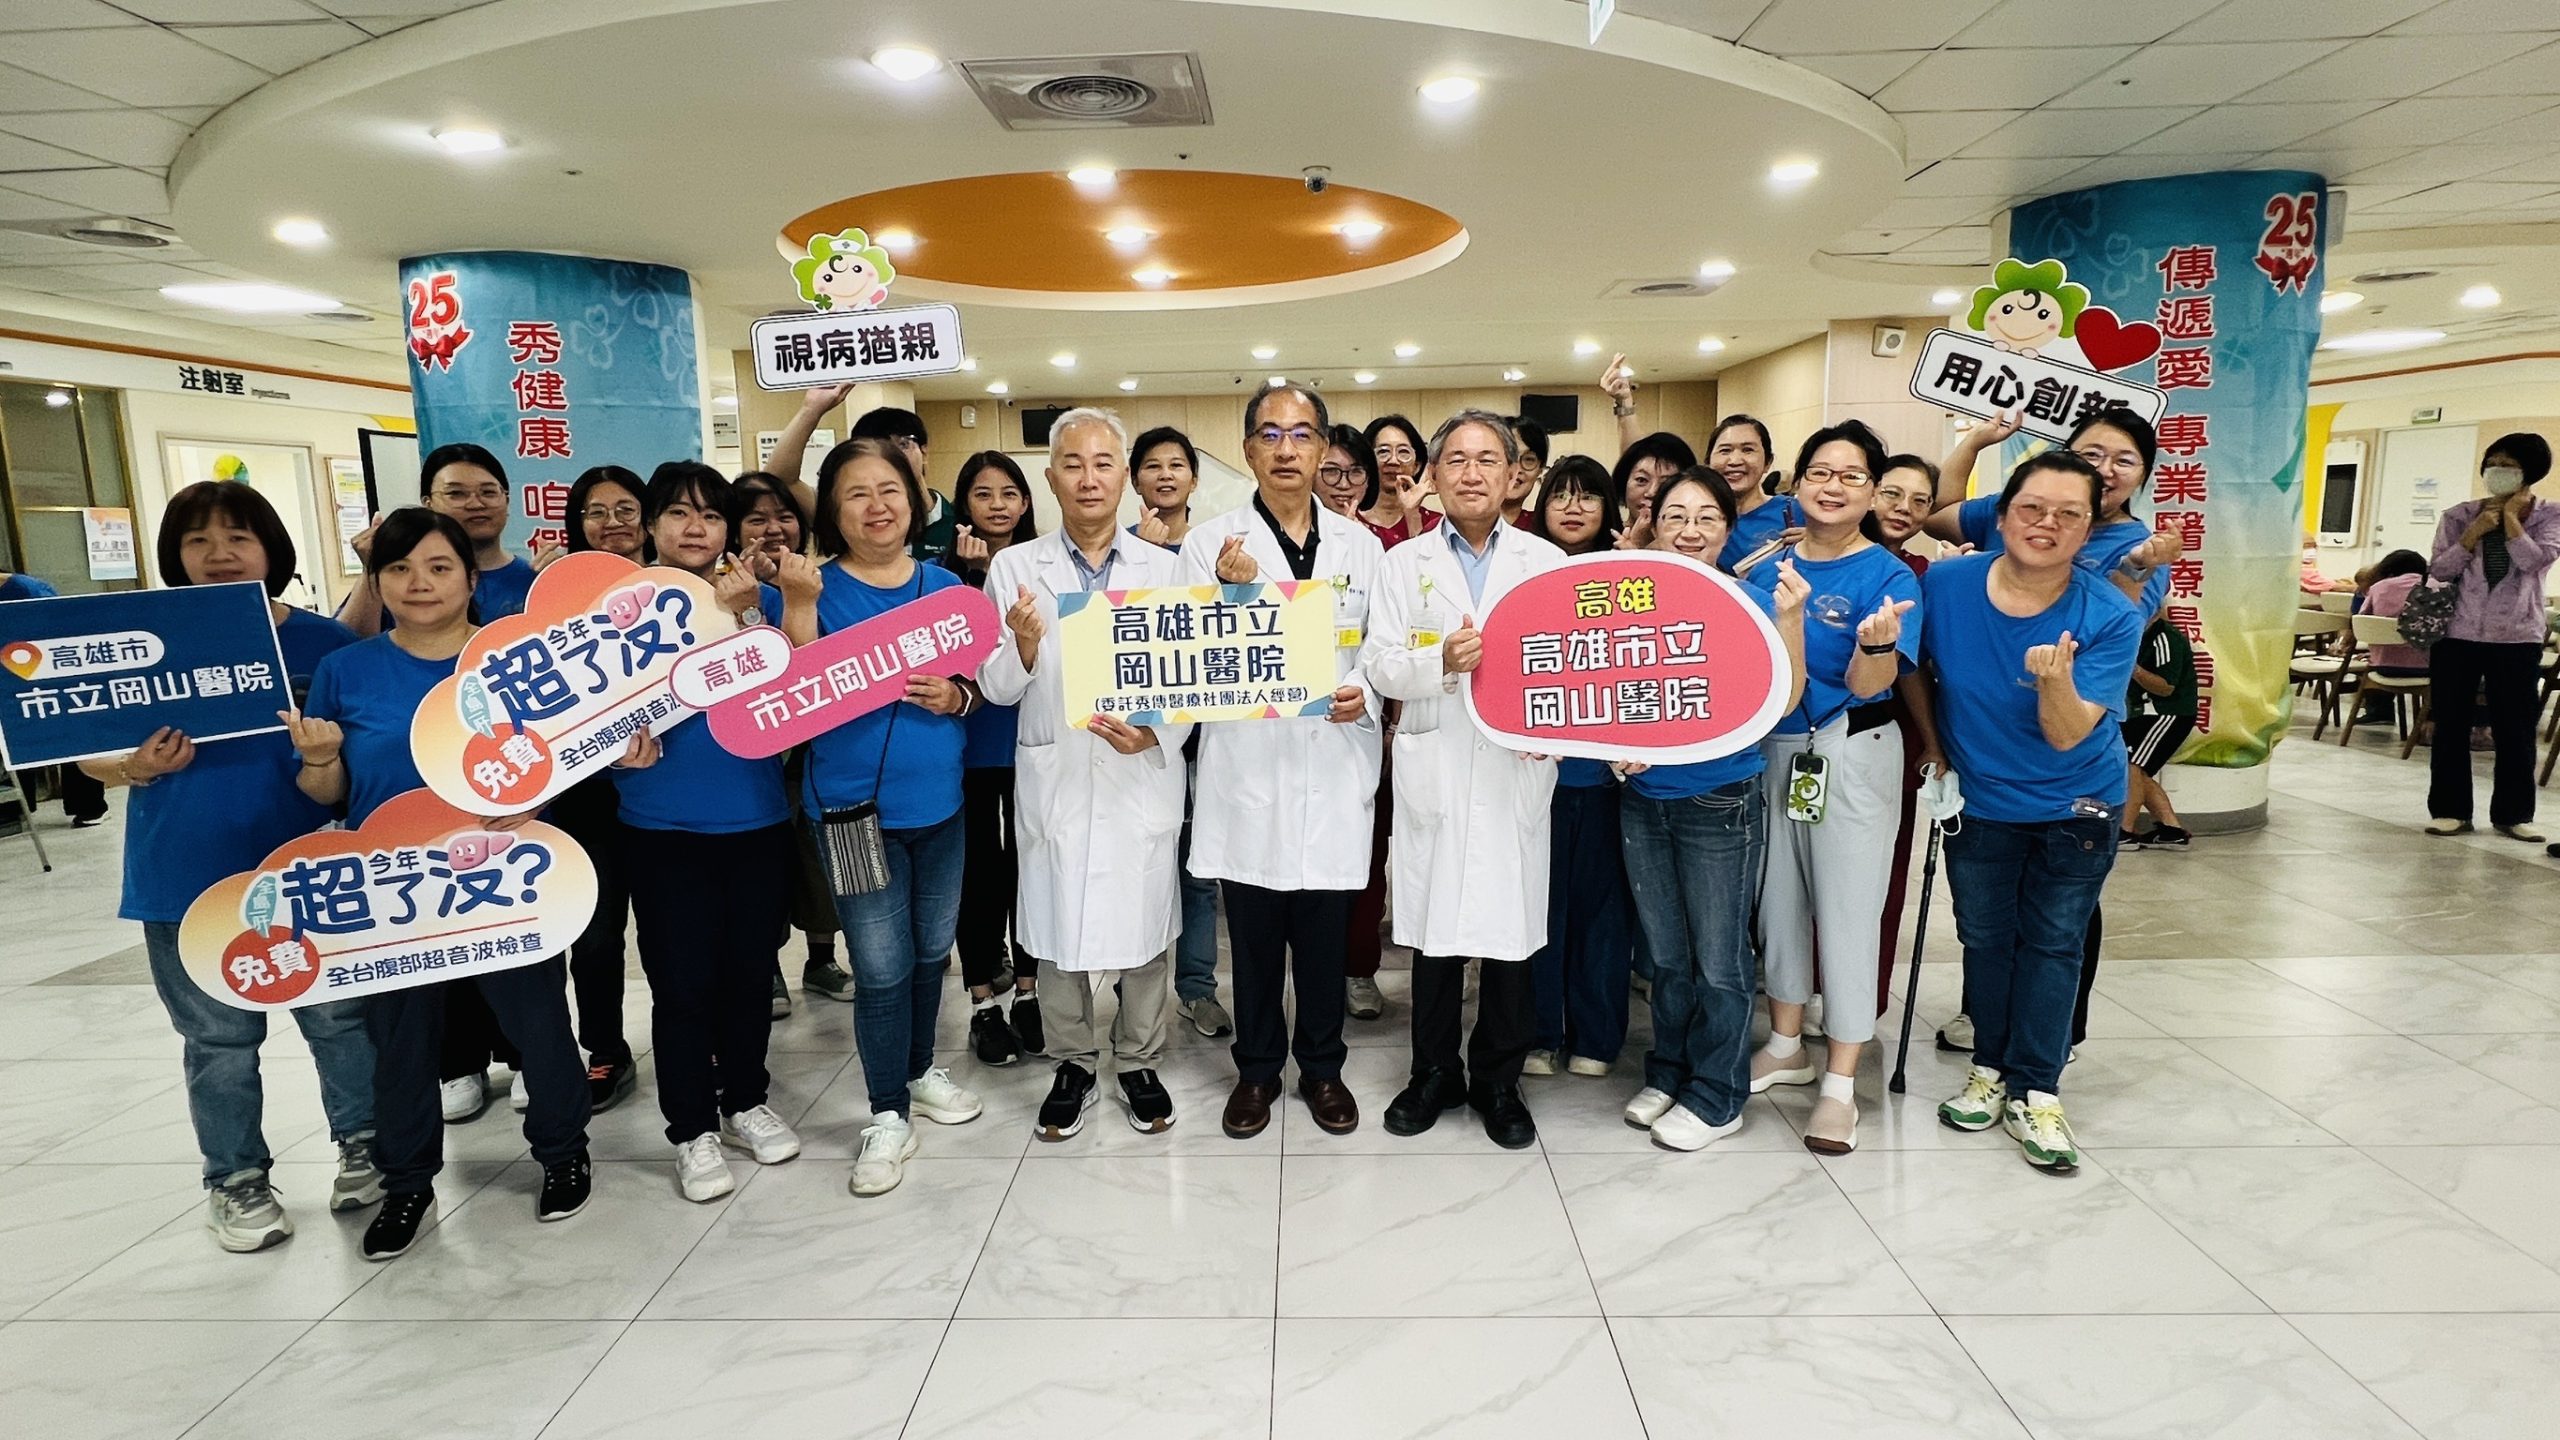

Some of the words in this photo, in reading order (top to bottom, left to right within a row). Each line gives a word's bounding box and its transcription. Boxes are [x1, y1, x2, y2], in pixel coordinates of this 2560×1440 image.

[2264, 195, 2316, 247] 25
[409, 273, 460, 328] 25
[2157, 246, 2216, 389] 傳遞愛
[774, 322, 939, 373] 視病猶親
[178, 365, 245, 395] 注射室
[508, 322, 571, 458] 秀健康
[1110, 599, 1284, 644] 高雄市立
[1574, 576, 1656, 619] 高雄
[48, 638, 149, 669] 高雄市
[547, 618, 590, 650] 今年
[1520, 621, 1707, 676] 高雄市立
[15, 661, 273, 719] 市立岡山醫院
[697, 644, 768, 692] 高雄
[746, 612, 974, 731] 市立岡山醫院
[1115, 644, 1286, 689] 岡山醫院
[1522, 676, 1711, 729] 岡山醫院
[472, 734, 546, 800] 免費
[368, 850, 420, 875] 今年
[229, 940, 313, 993] 免費
[326, 932, 543, 988] 全台腹部超音波檢查
